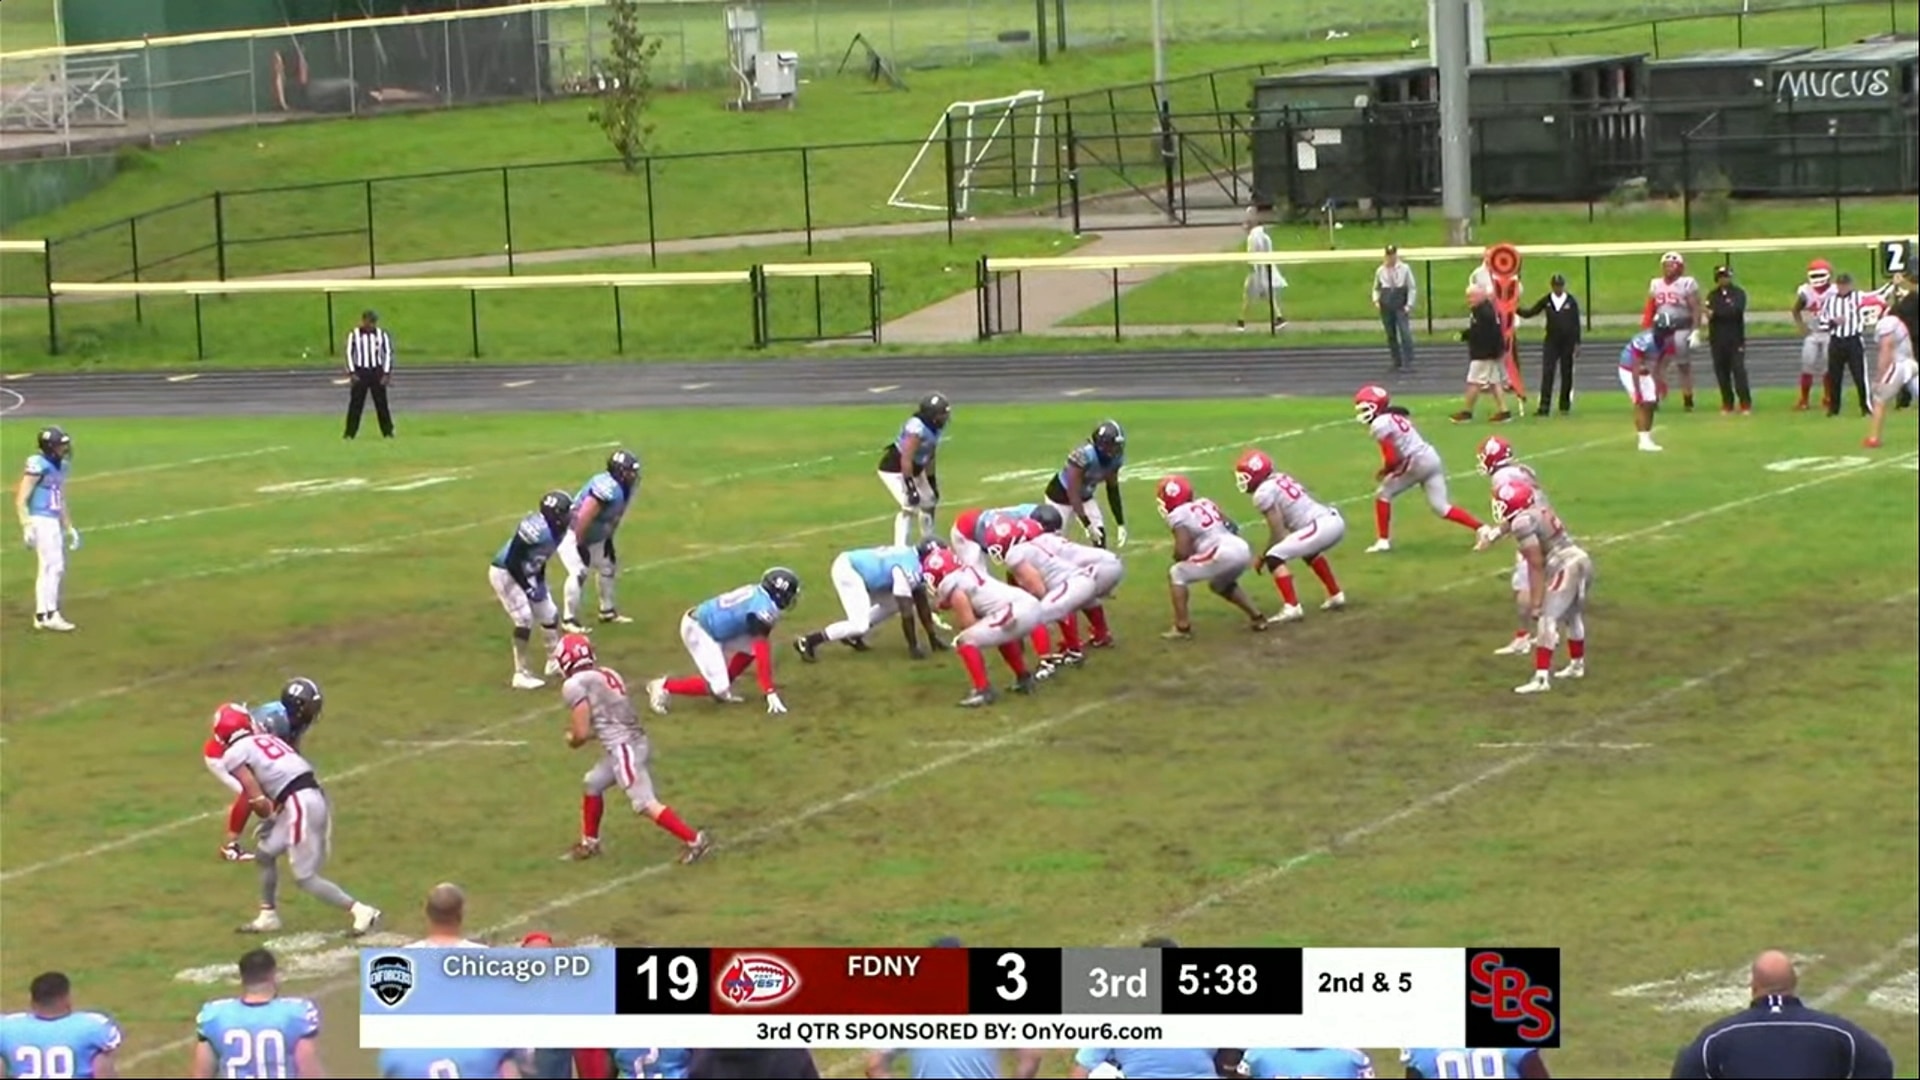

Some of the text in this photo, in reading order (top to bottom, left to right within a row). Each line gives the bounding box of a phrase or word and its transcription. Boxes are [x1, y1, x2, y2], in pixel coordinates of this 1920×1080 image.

[1776, 68, 1890, 103] MUCUS
[1887, 243, 1905, 271] 2
[224, 1028, 286, 1079] 20
